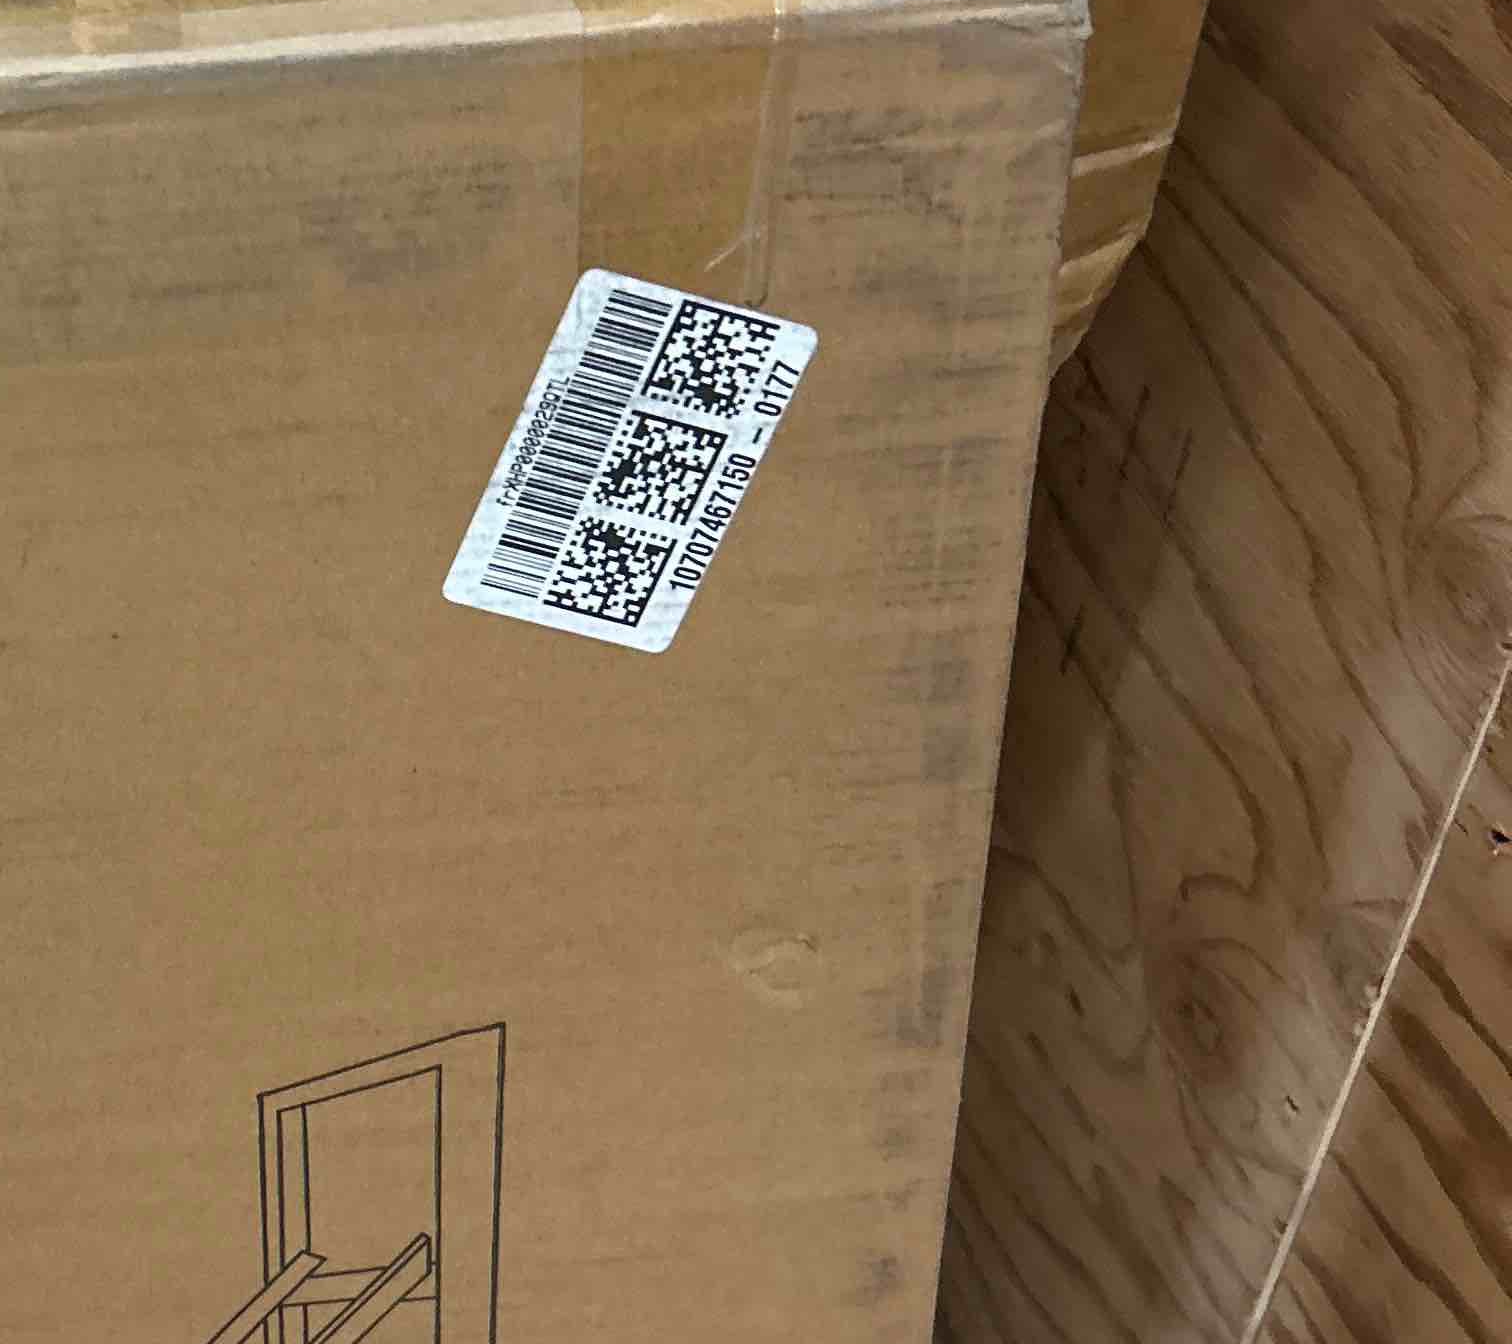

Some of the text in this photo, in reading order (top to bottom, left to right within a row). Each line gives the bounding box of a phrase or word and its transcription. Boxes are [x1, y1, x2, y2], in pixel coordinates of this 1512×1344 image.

[497, 375, 572, 508] frXHP0000029QTL
[669, 453, 756, 591] 10707467150
[754, 359, 800, 418] 0177
